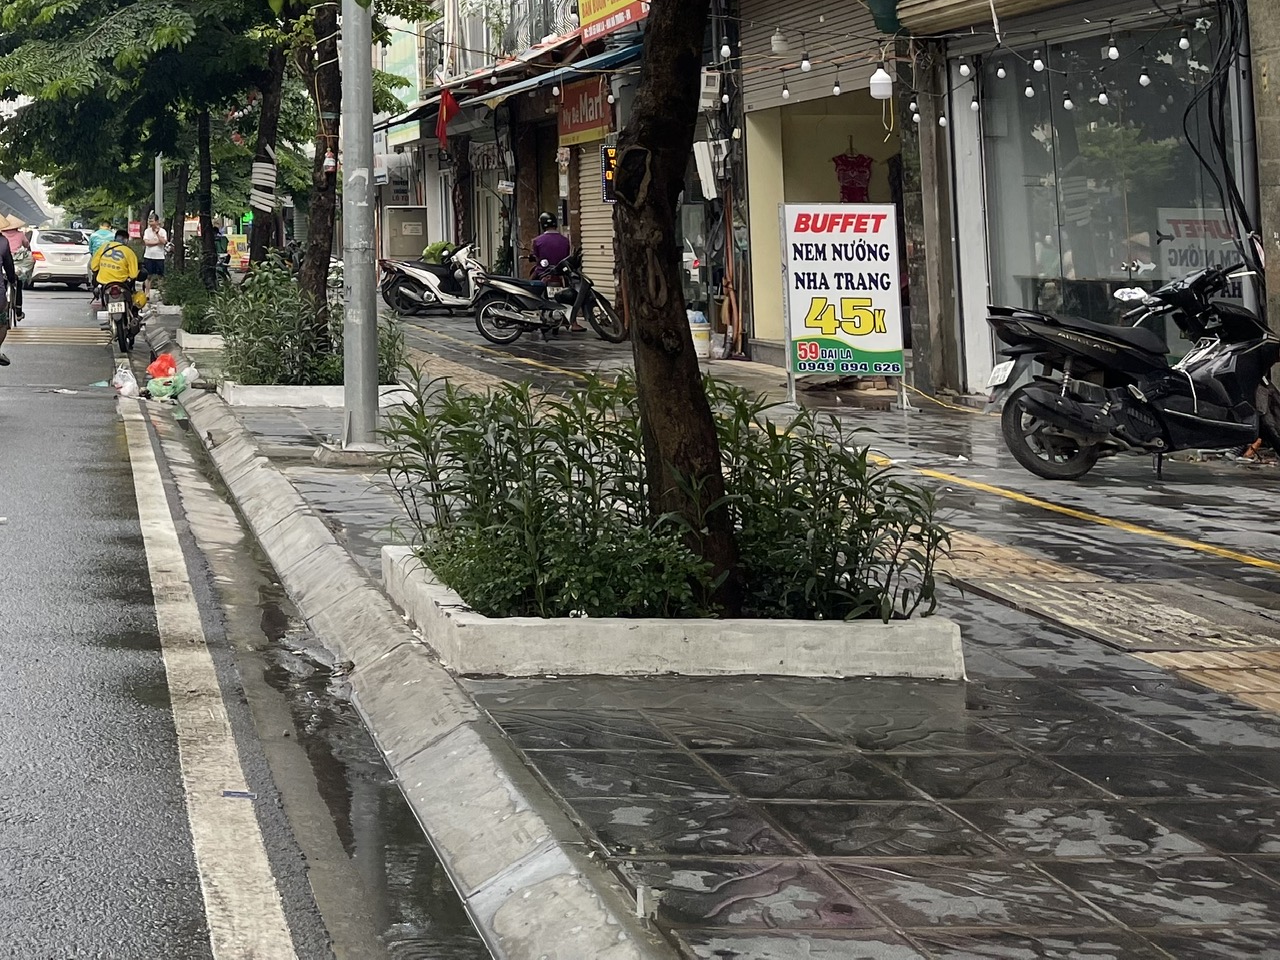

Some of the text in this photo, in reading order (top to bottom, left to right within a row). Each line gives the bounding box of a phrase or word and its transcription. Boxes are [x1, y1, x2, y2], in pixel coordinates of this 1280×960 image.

[580, 91, 605, 123] Mart
[794, 213, 887, 233] BUFFET
[792, 239, 890, 262] NEM NƯỚNG
[794, 272, 891, 290] NHA TRANG
[797, 342, 853, 361] 59 ĐẠI LA
[798, 362, 900, 372] 0949 894 626
